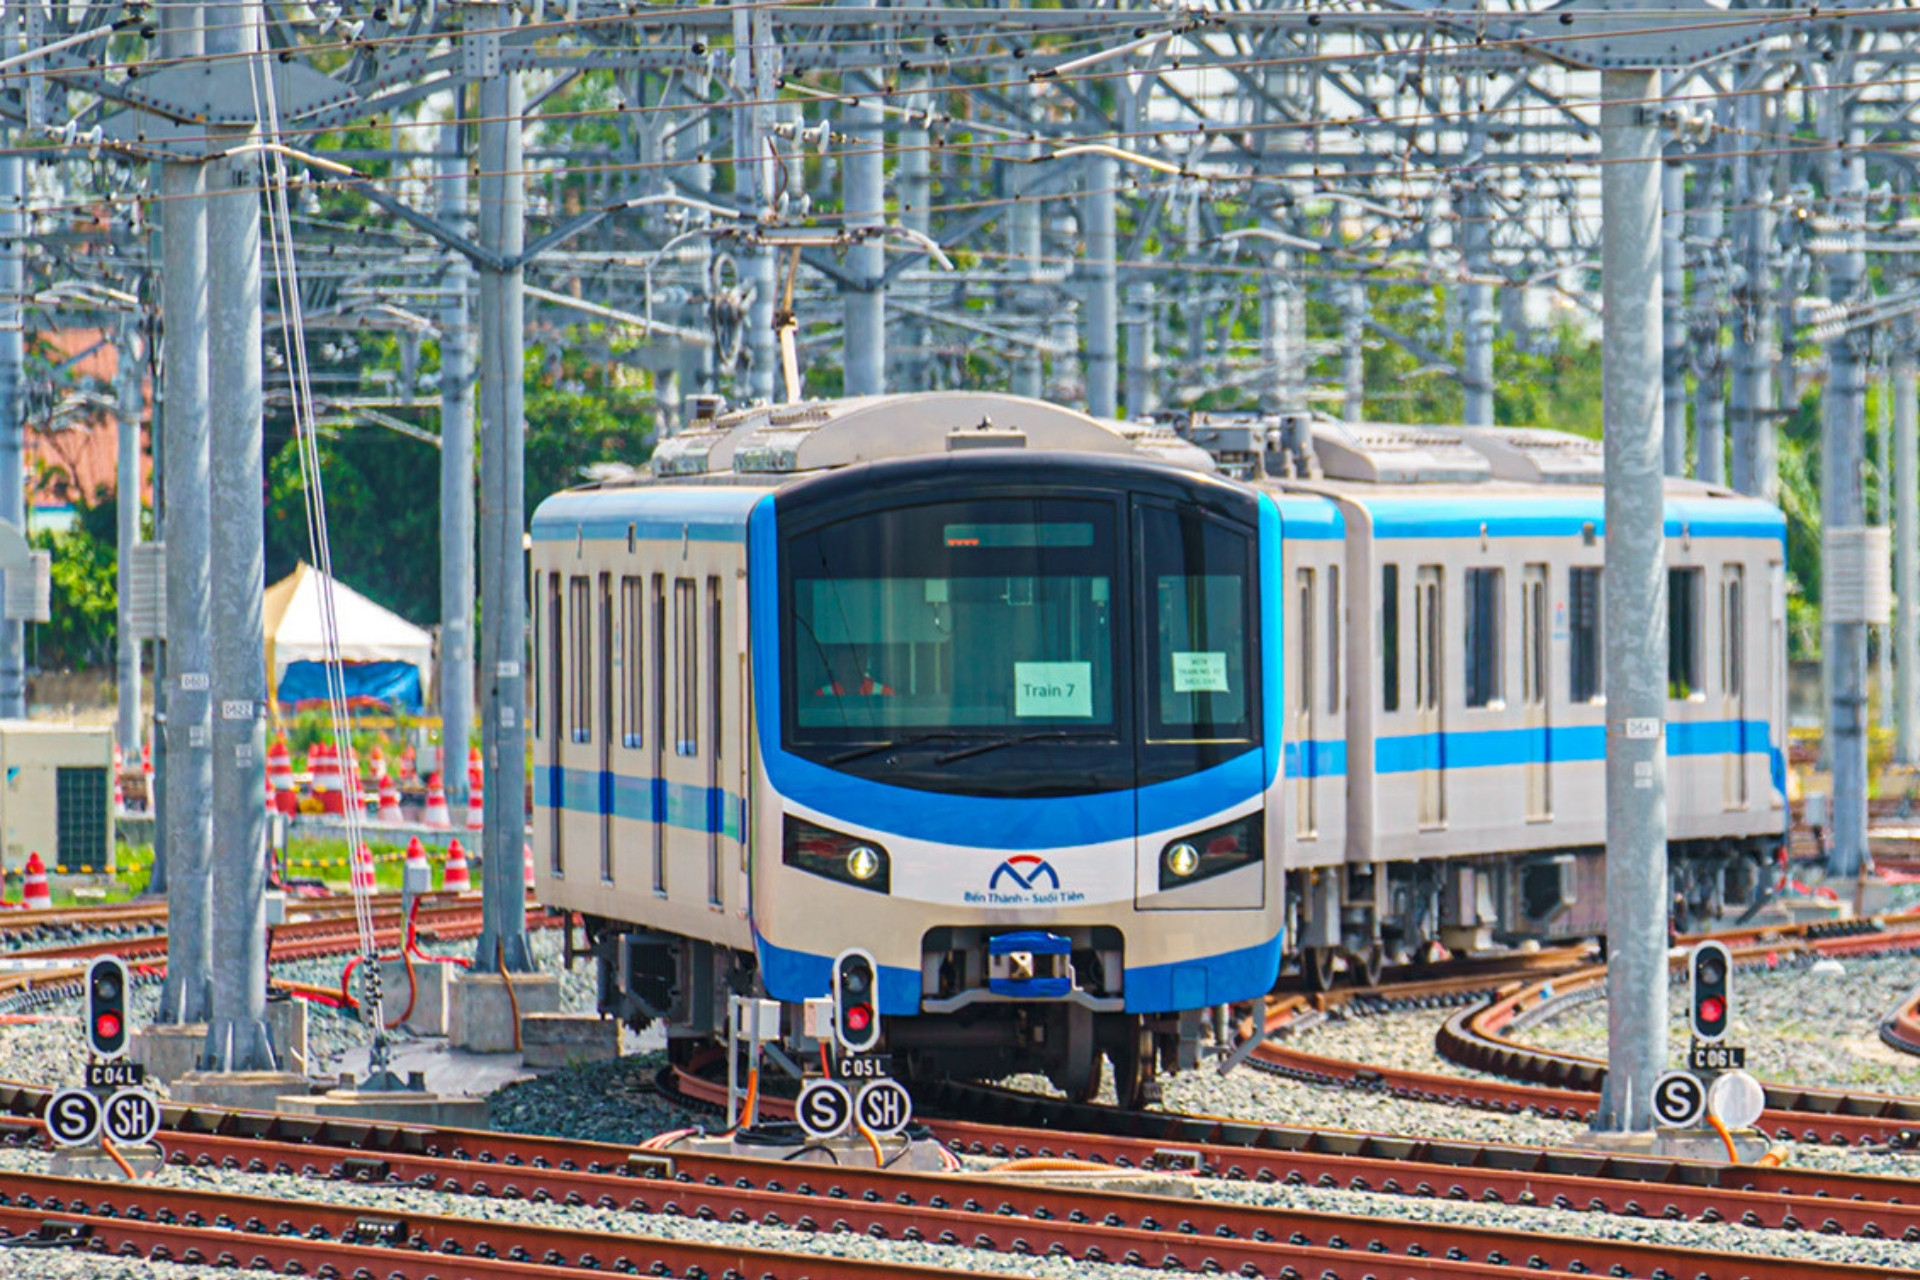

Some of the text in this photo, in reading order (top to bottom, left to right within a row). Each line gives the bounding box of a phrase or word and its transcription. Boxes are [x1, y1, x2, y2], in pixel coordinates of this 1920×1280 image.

[1023, 683, 1076, 698] Train 7
[91, 1066, 137, 1085] C04L
[840, 1058, 886, 1078] C05L
[60, 1098, 87, 1137] S
[114, 1098, 147, 1137] SH
[810, 1089, 837, 1128] S
[867, 1089, 899, 1127] SH
[1664, 1079, 1691, 1118] S
